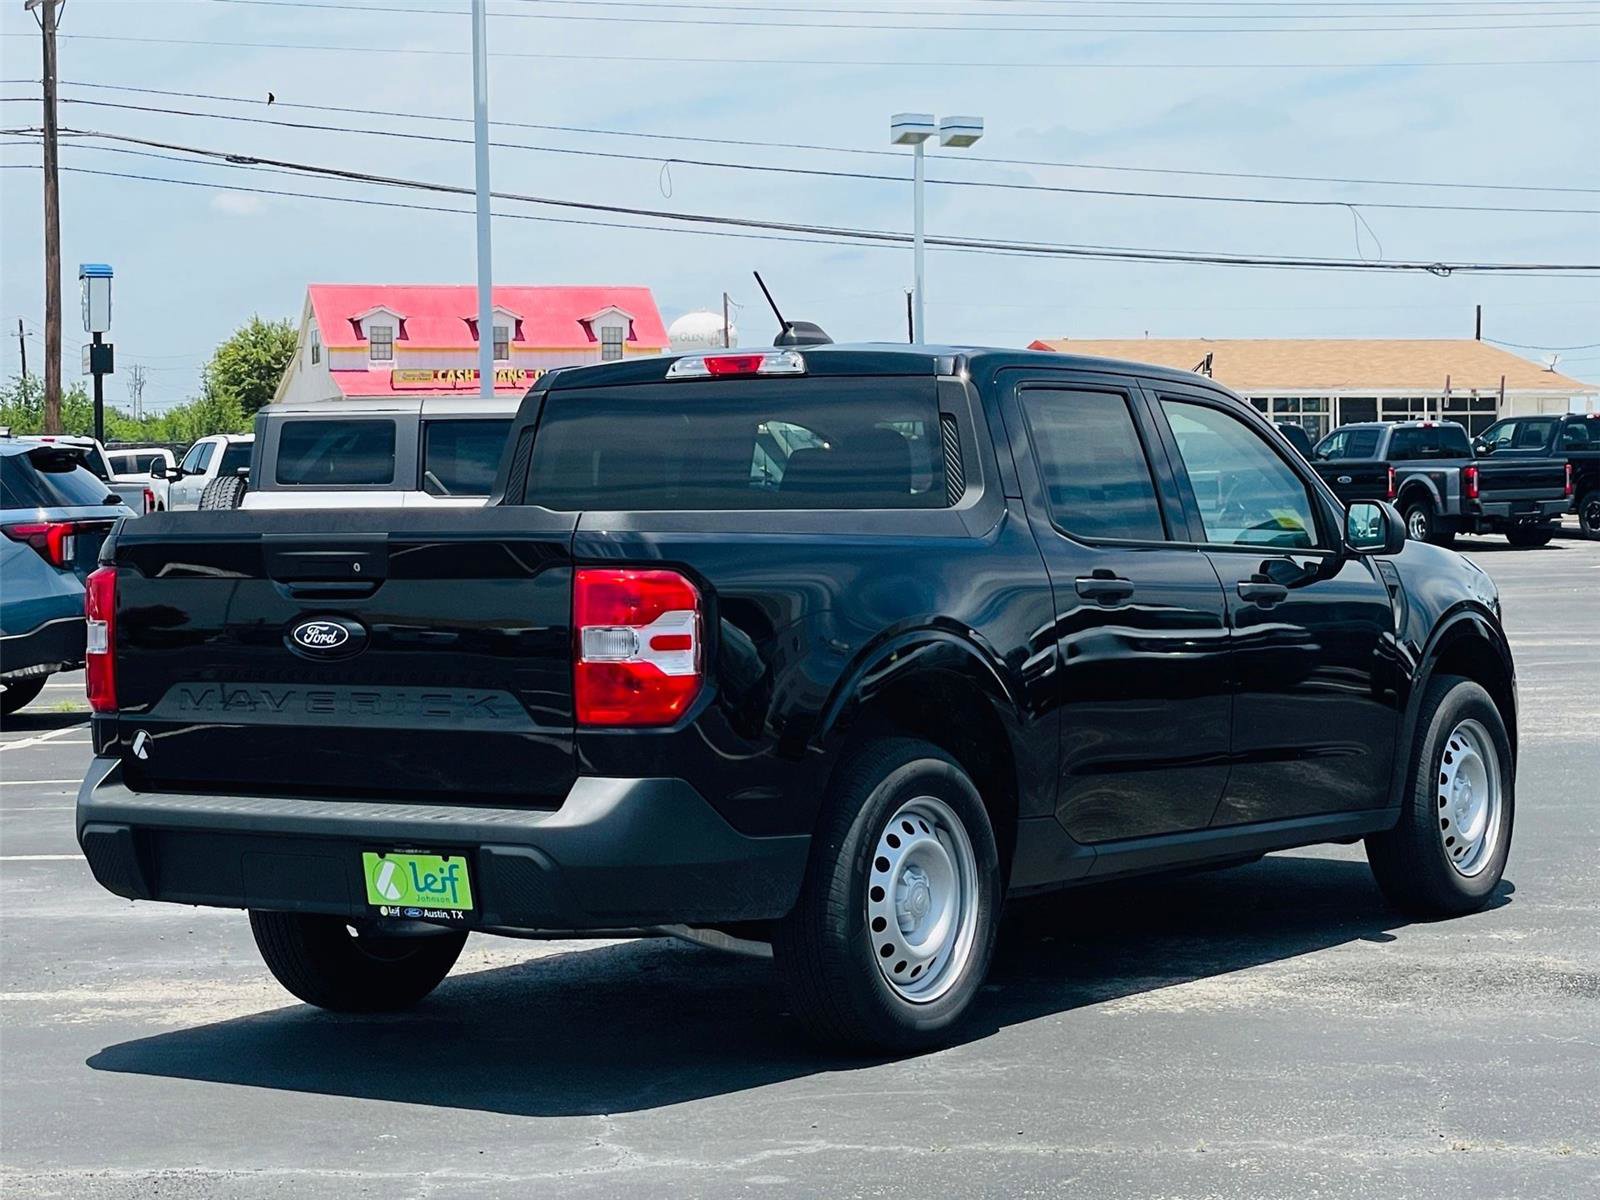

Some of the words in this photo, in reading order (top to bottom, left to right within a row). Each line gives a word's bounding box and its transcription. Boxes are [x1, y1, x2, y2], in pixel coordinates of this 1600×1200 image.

[438, 369, 474, 381] CASH
[495, 369, 525, 382] ANS
[304, 625, 338, 644] Ford
[179, 687, 502, 719] MAVERICK
[416, 894, 450, 903] Johnson
[424, 909, 450, 919] Austin,
[451, 910, 464, 920] TX
